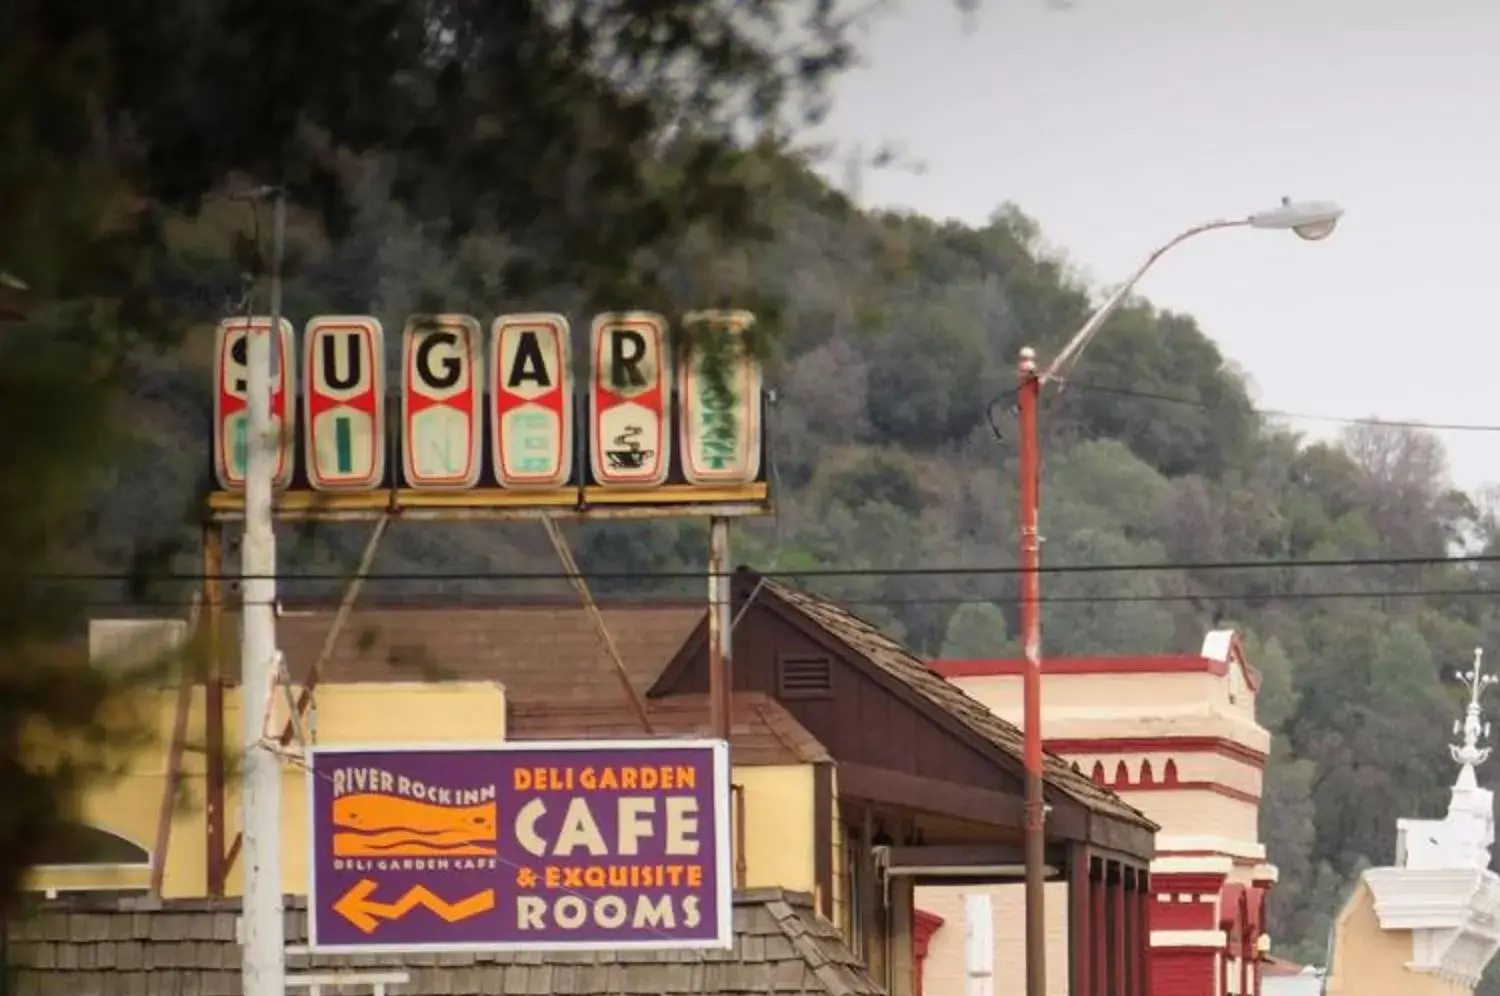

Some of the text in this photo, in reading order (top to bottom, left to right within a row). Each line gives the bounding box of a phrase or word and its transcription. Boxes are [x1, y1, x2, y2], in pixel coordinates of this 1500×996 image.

[234, 414, 553, 476] INE
[333, 767, 496, 805] RIVER ROCK INN
[514, 766, 696, 791] DELI GARDEN
[514, 796, 701, 858] CAFE
[333, 858, 497, 871] DELI GARDEN CAFE
[516, 865, 703, 888] & EXQUISITE
[516, 894, 701, 931] ROOMS
